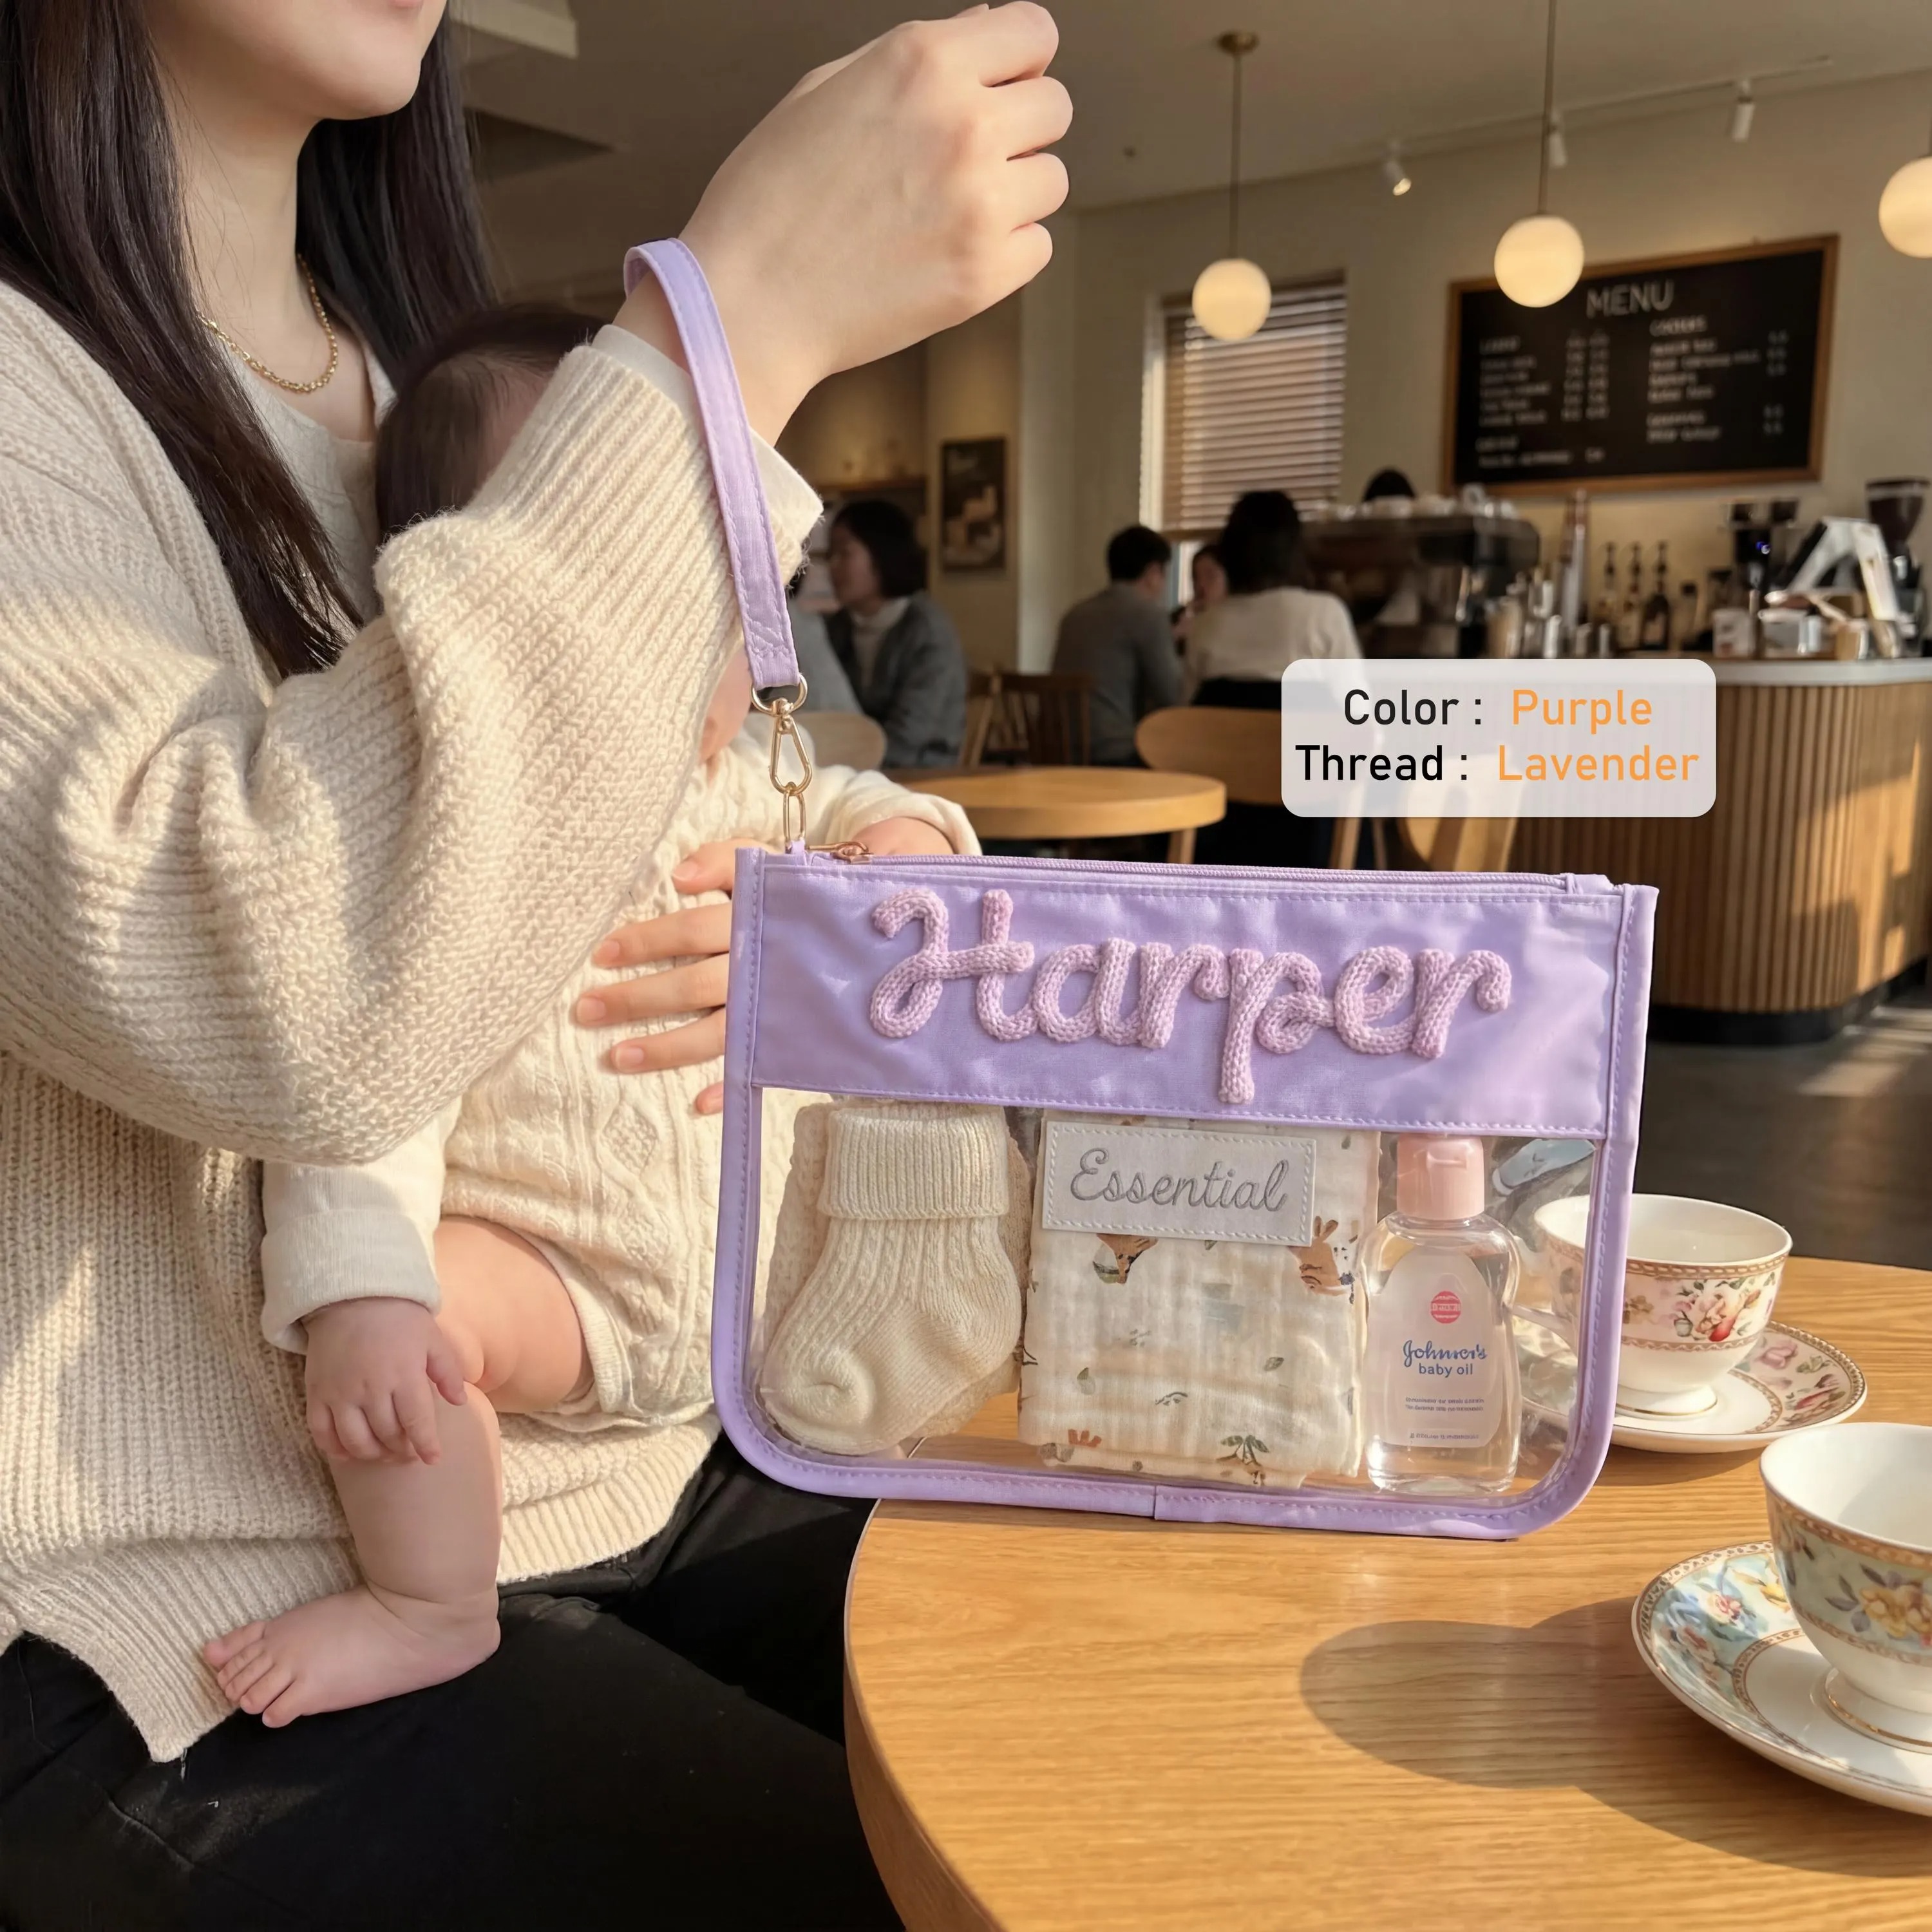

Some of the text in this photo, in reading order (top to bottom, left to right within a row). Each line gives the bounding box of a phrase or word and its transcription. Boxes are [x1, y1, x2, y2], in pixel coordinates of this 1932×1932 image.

[1586, 279, 1674, 319] MENU
[869, 888, 1511, 1103] Harper
[1070, 1147, 1289, 1212] Essential
[1419, 1363, 1473, 1378] baby oil
